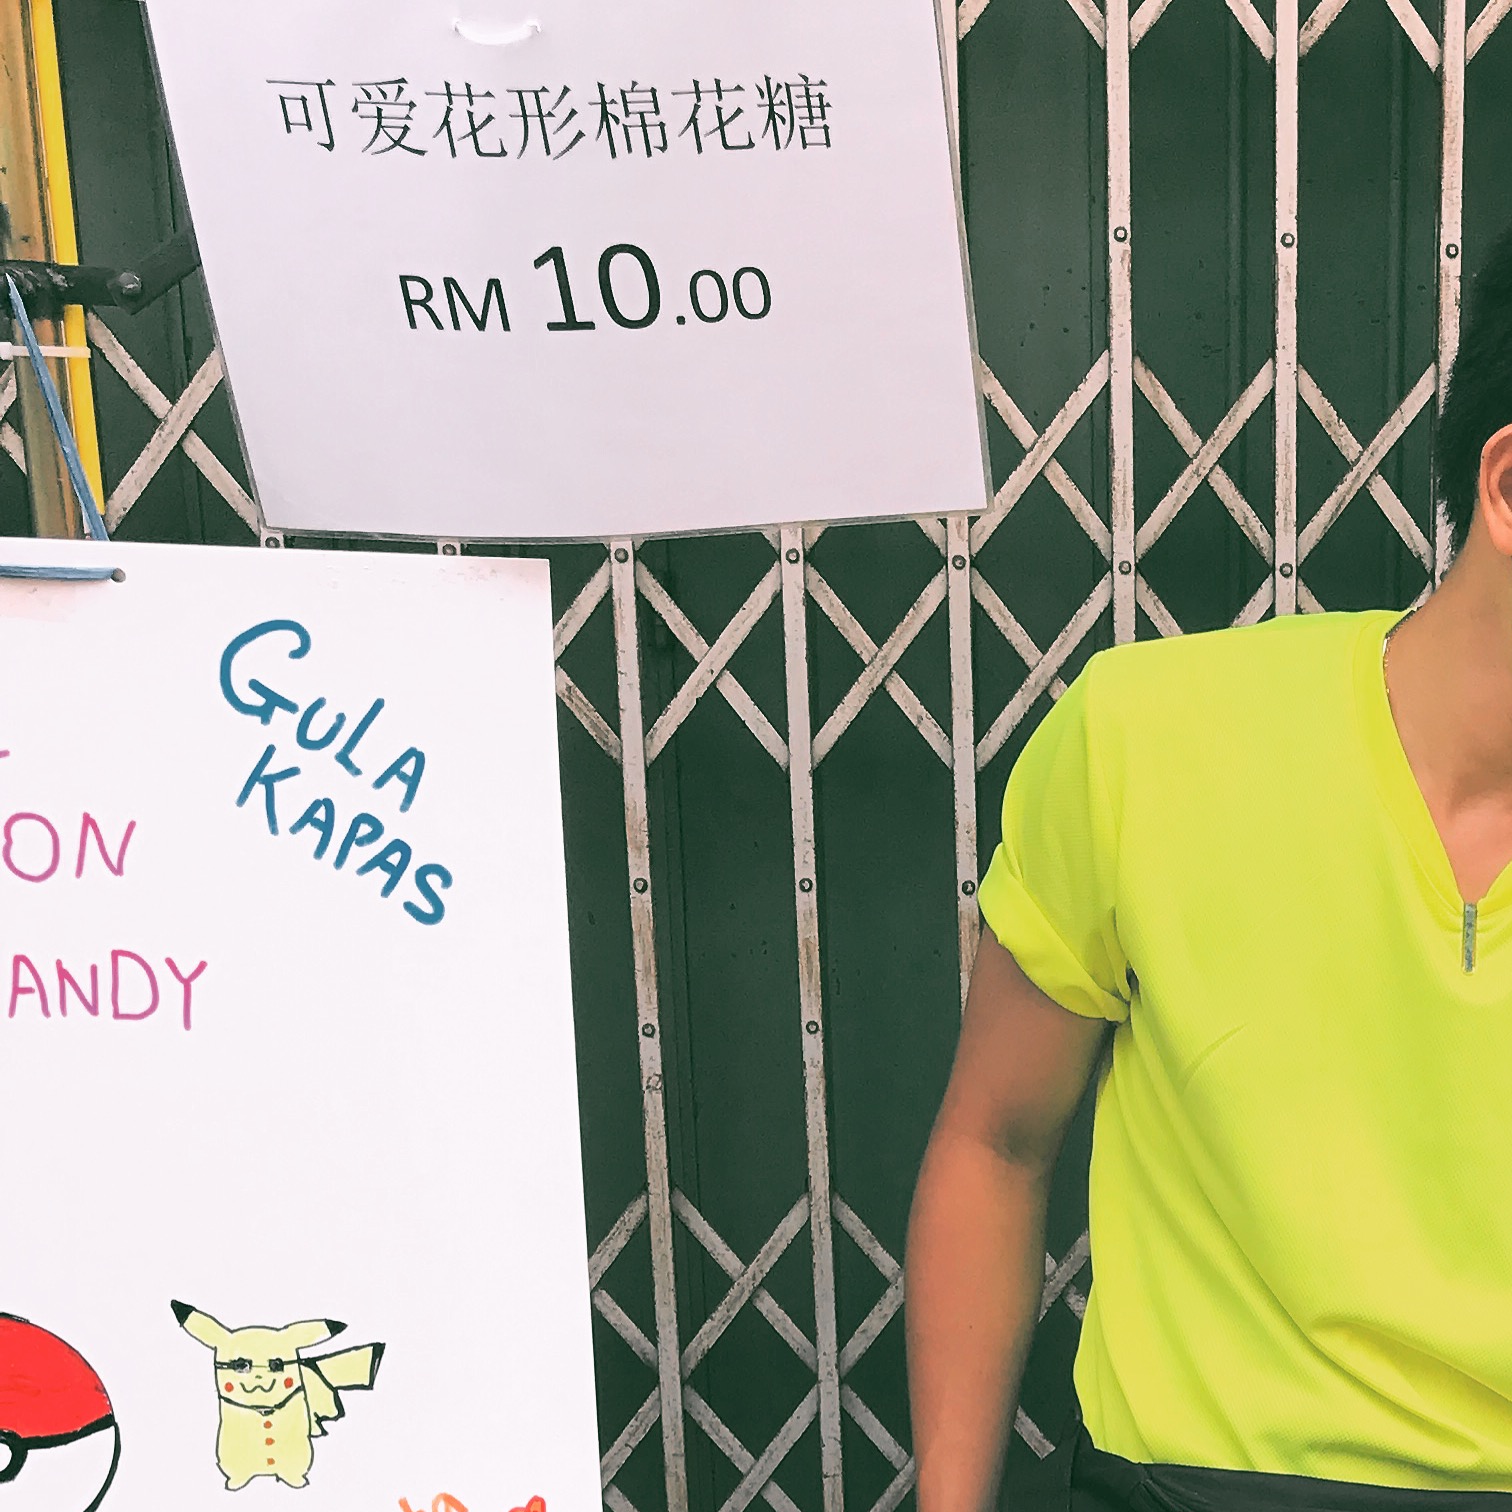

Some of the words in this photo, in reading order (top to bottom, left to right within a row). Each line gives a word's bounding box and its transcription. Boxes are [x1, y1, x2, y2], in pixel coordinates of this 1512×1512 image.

[266, 73, 832, 160] 可爱花形棉花糖
[399, 275, 511, 332] RM
[533, 243, 772, 332] 10.00
[219, 619, 426, 812] GULA
[236, 744, 453, 926] KAPAS
